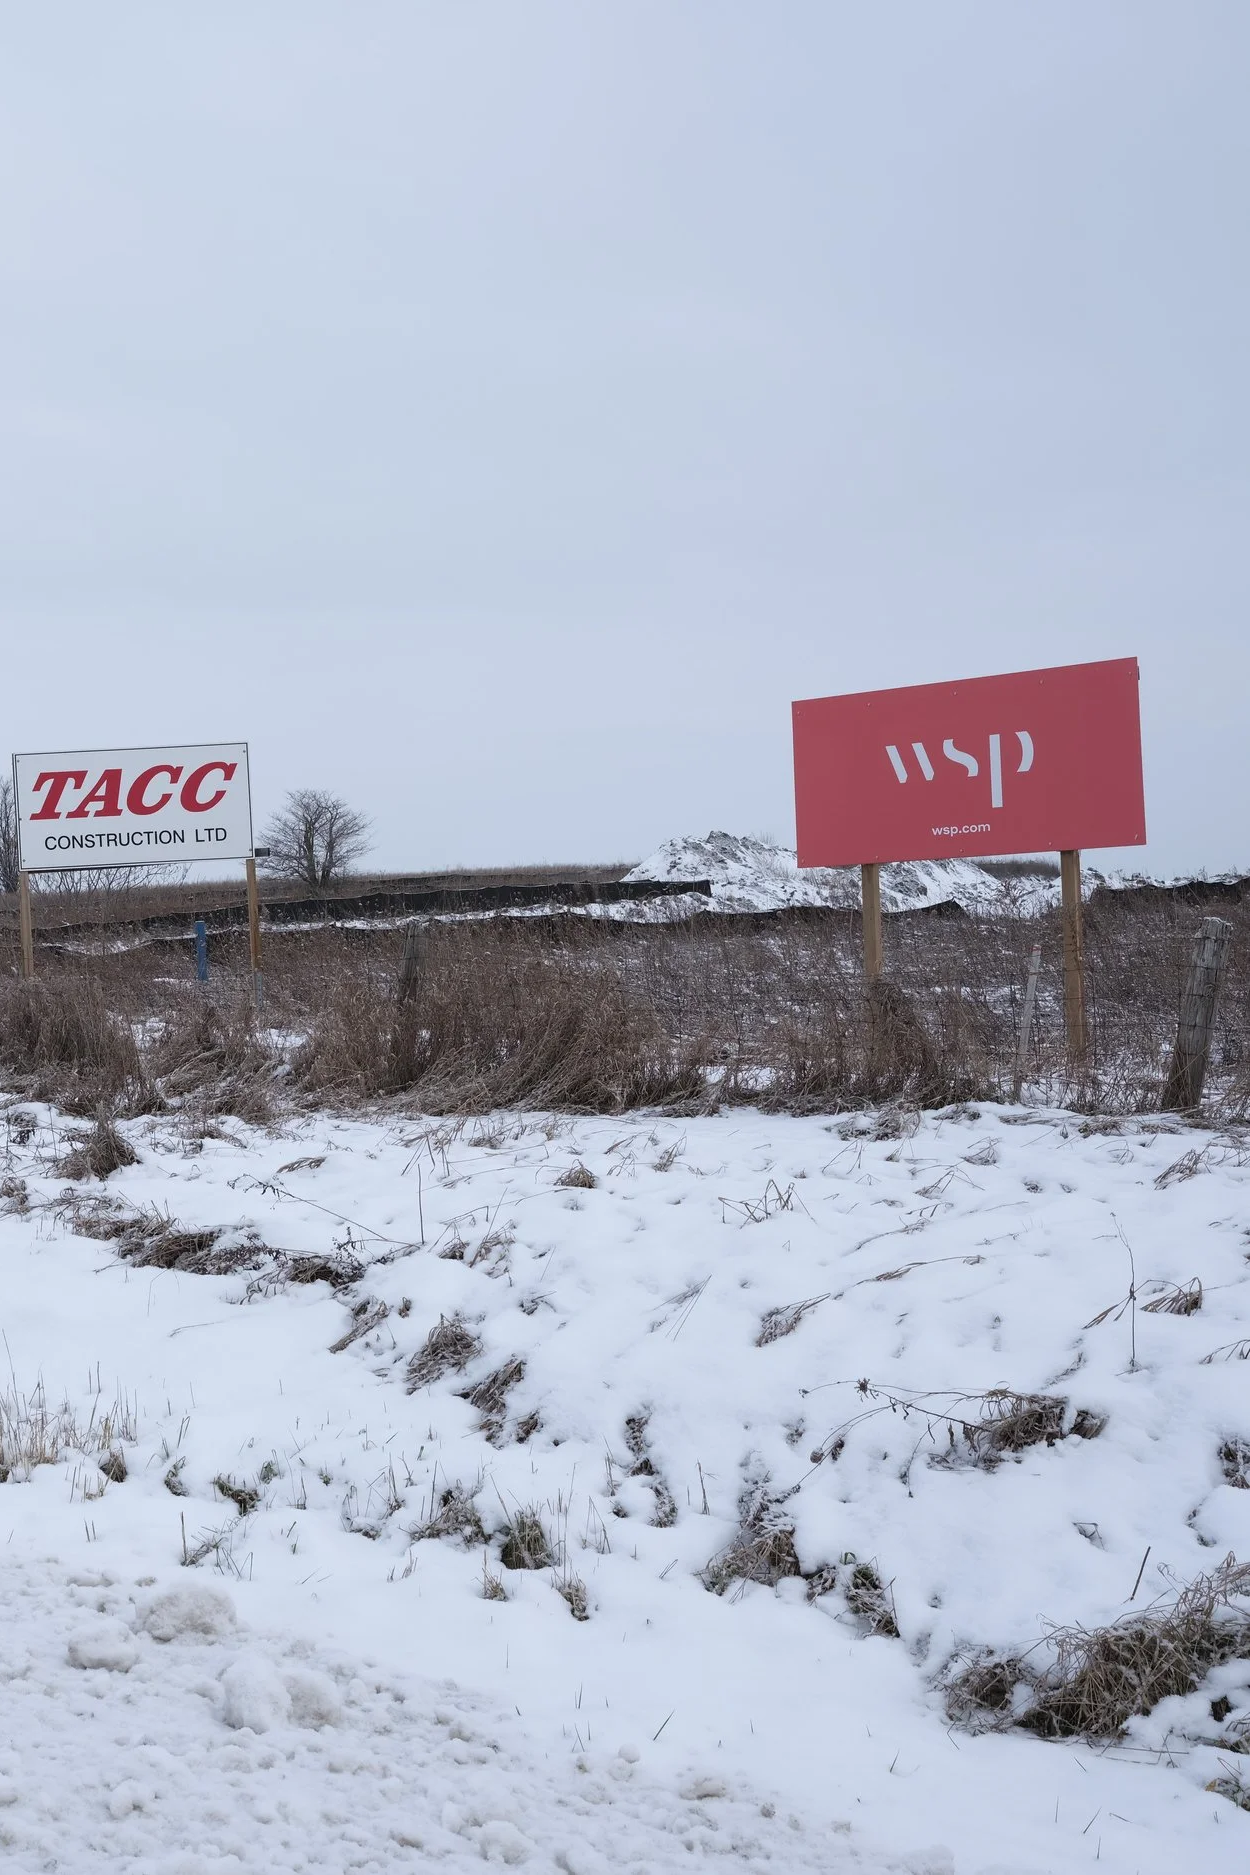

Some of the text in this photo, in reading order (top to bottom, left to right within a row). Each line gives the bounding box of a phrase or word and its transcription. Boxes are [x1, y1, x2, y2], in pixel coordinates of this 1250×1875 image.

[885, 730, 1035, 809] wsp
[29, 761, 238, 821] TACC
[44, 827, 228, 851] CONSTRUCTION LTD
[931, 821, 991, 838] wsp.com
